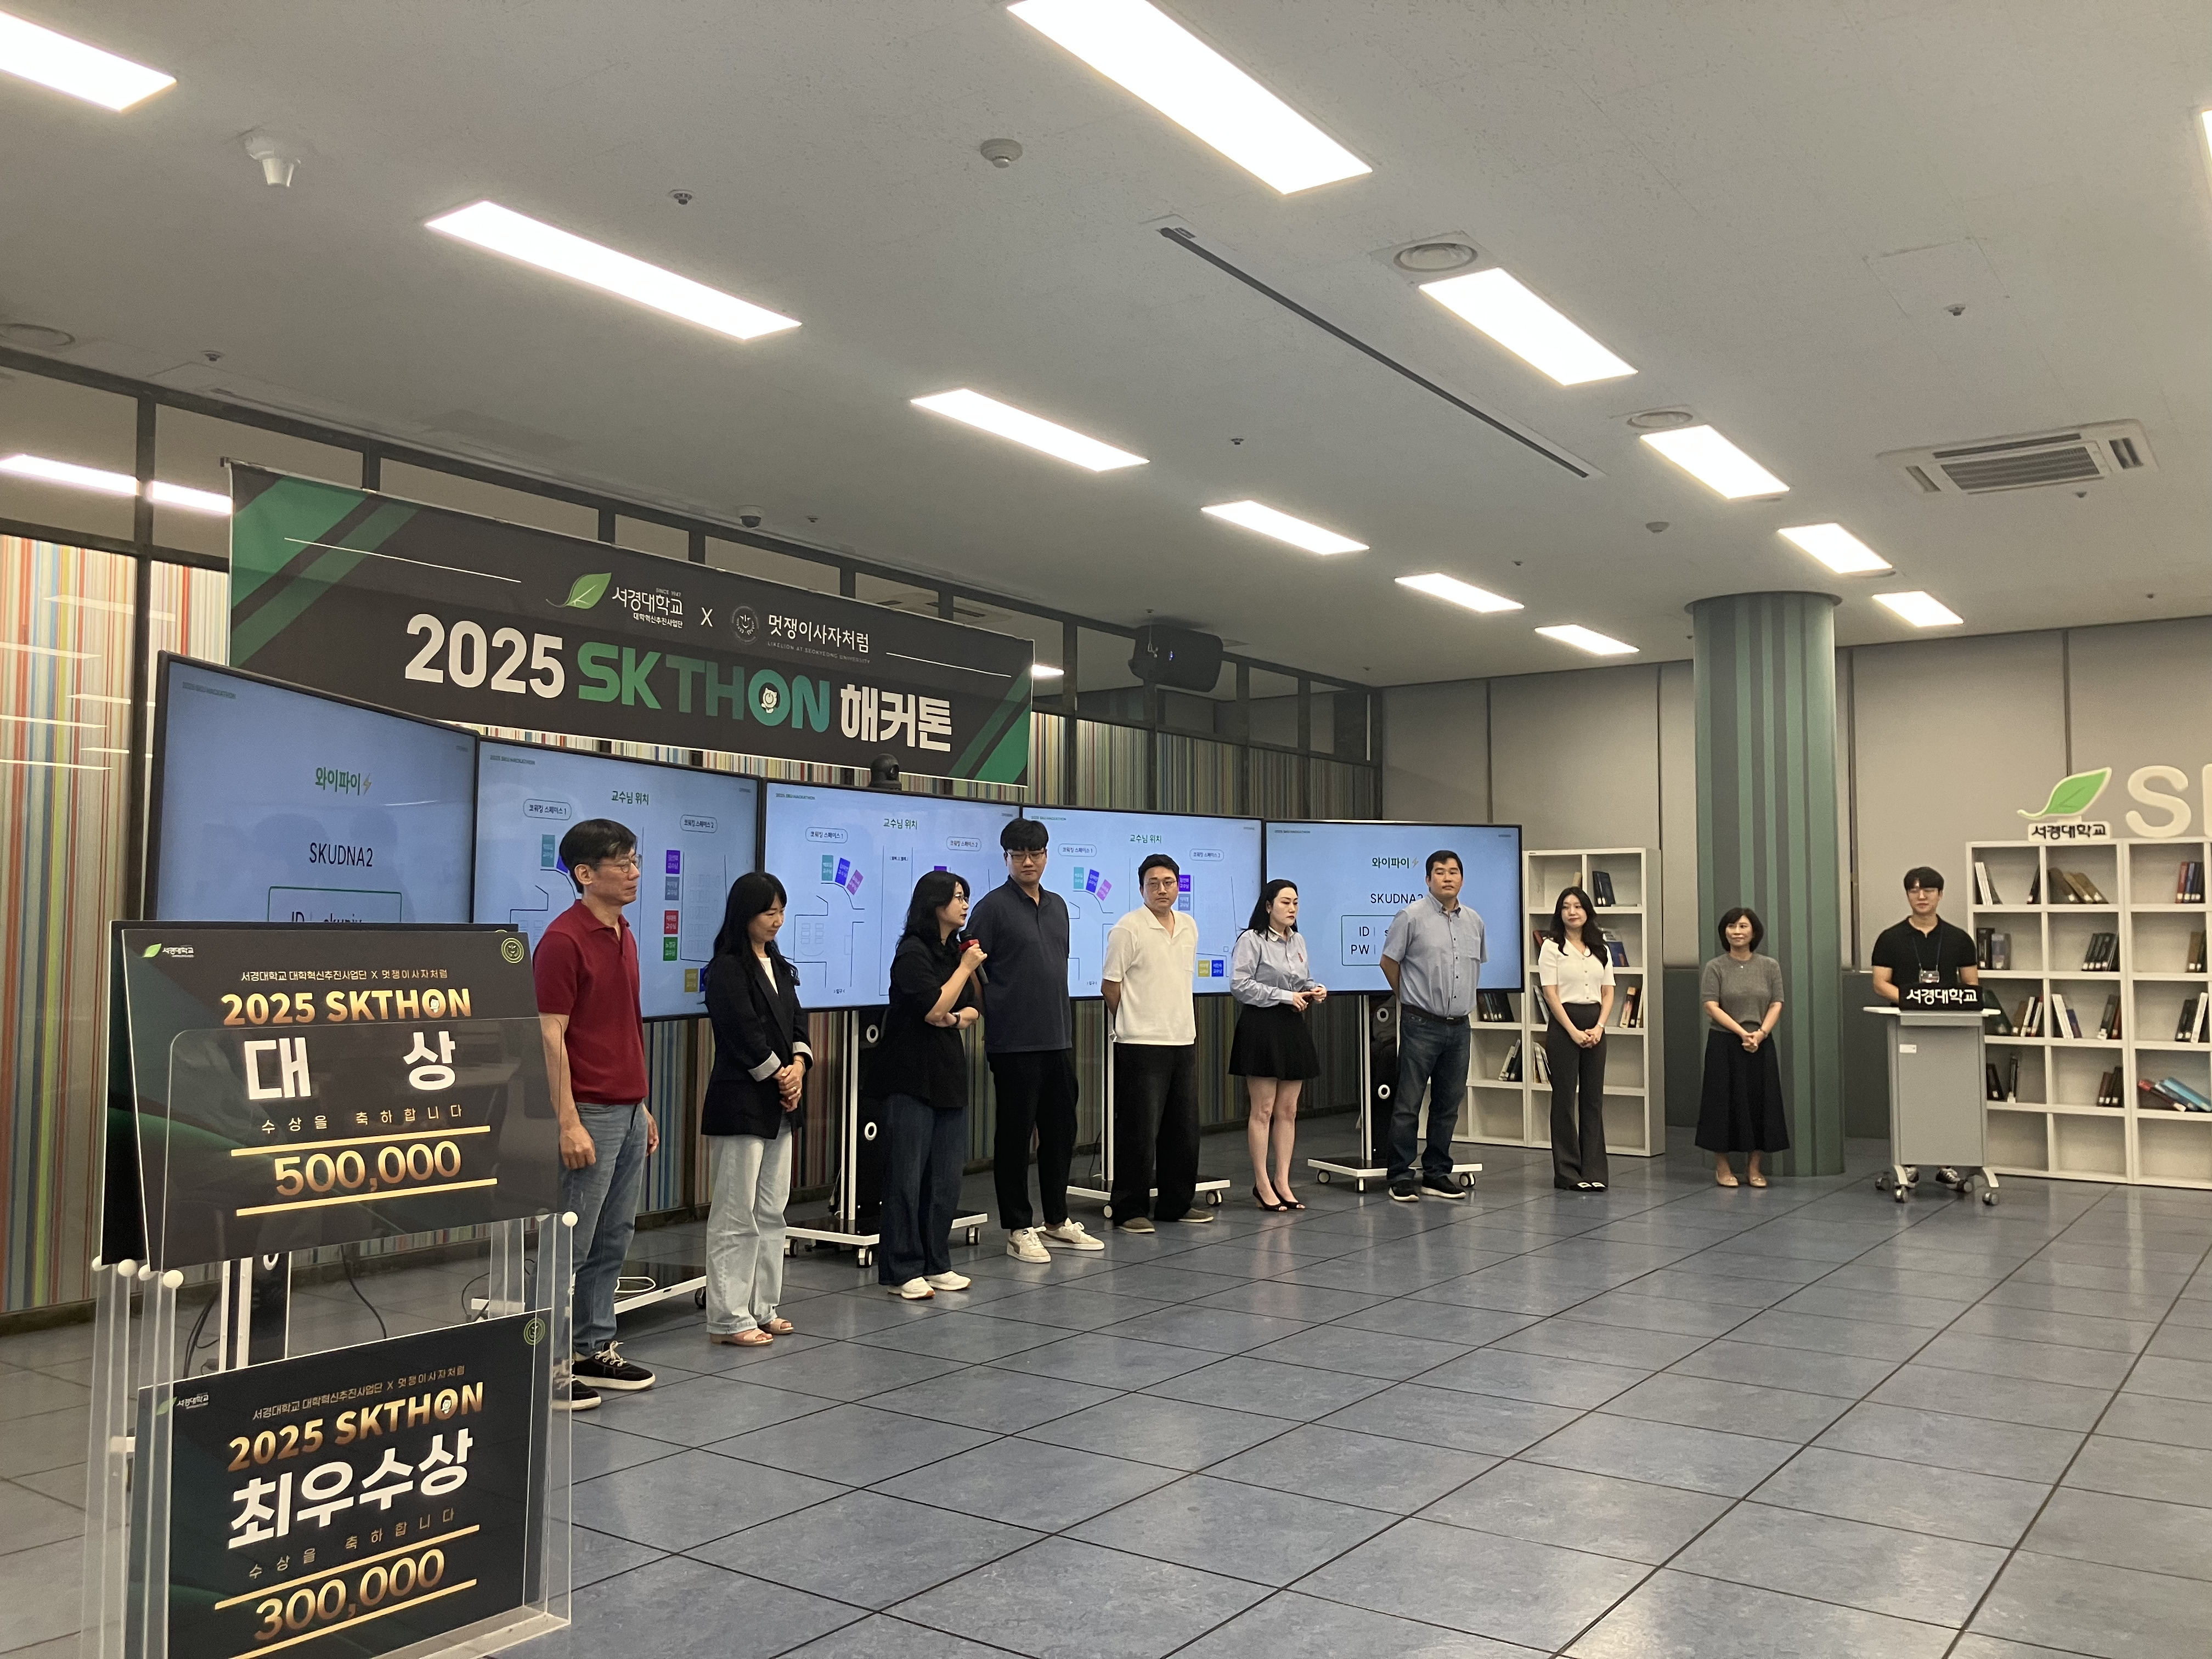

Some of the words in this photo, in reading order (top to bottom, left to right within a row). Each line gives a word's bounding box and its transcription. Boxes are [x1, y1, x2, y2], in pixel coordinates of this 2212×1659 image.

[612, 587, 683, 616] 서경대학교
[633, 612, 683, 628] 대학혁신추진사업단
[701, 607, 713, 627] X
[769, 614, 868, 653] 멋쟁이사자처럼
[768, 641, 794, 650] LIKELION
[805, 648, 838, 658] SEOKYEONG
[839, 654, 871, 664] UNIVERSITY
[405, 613, 565, 698] 2025
[577, 641, 830, 733] SKTHON
[840, 684, 952, 752] 해커톤
[315, 767, 360, 795] 와이파이
[612, 791, 633, 804] 교수님
[635, 792, 649, 805] 위치
[2126, 764, 2212, 838] S
[883, 818, 903, 829] 교수님
[905, 819, 917, 830] 위치
[2032, 824, 2106, 840] 서경대학교
[1130, 834, 1148, 843] 교수님
[1150, 835, 1161, 844] 위치
[309, 842, 373, 867] SKUDNA2
[1372, 857, 1409, 869] 와이파이
[1359, 926, 1370, 937] ID
[1351, 945, 1369, 955] PW
[241, 970, 287, 982] 서경대학교
[289, 969, 367, 981] 대학혁신추진사업단
[371, 970, 378, 980] X
[382, 969, 448, 980] 멋쟁이사자처럼
[221, 991, 315, 1026] 2025
[326, 988, 472, 1022] SKTHON
[1906, 988, 1978, 1005] 서경대학교
[274, 1141, 461, 1196] 500,000
[252, 1401, 300, 1420] 서경대학교
[302, 1381, 383, 1410] 대학혁신추진사업단
[387, 1380, 394, 1391] X
[398, 1365, 465, 1387] 멋쟁이사자처럼
[227, 1418, 323, 1472] 2025
[335, 1381, 484, 1446] SKTHON
[227, 1427, 473, 1550] 최우수상
[255, 1548, 445, 1641] 300,000
